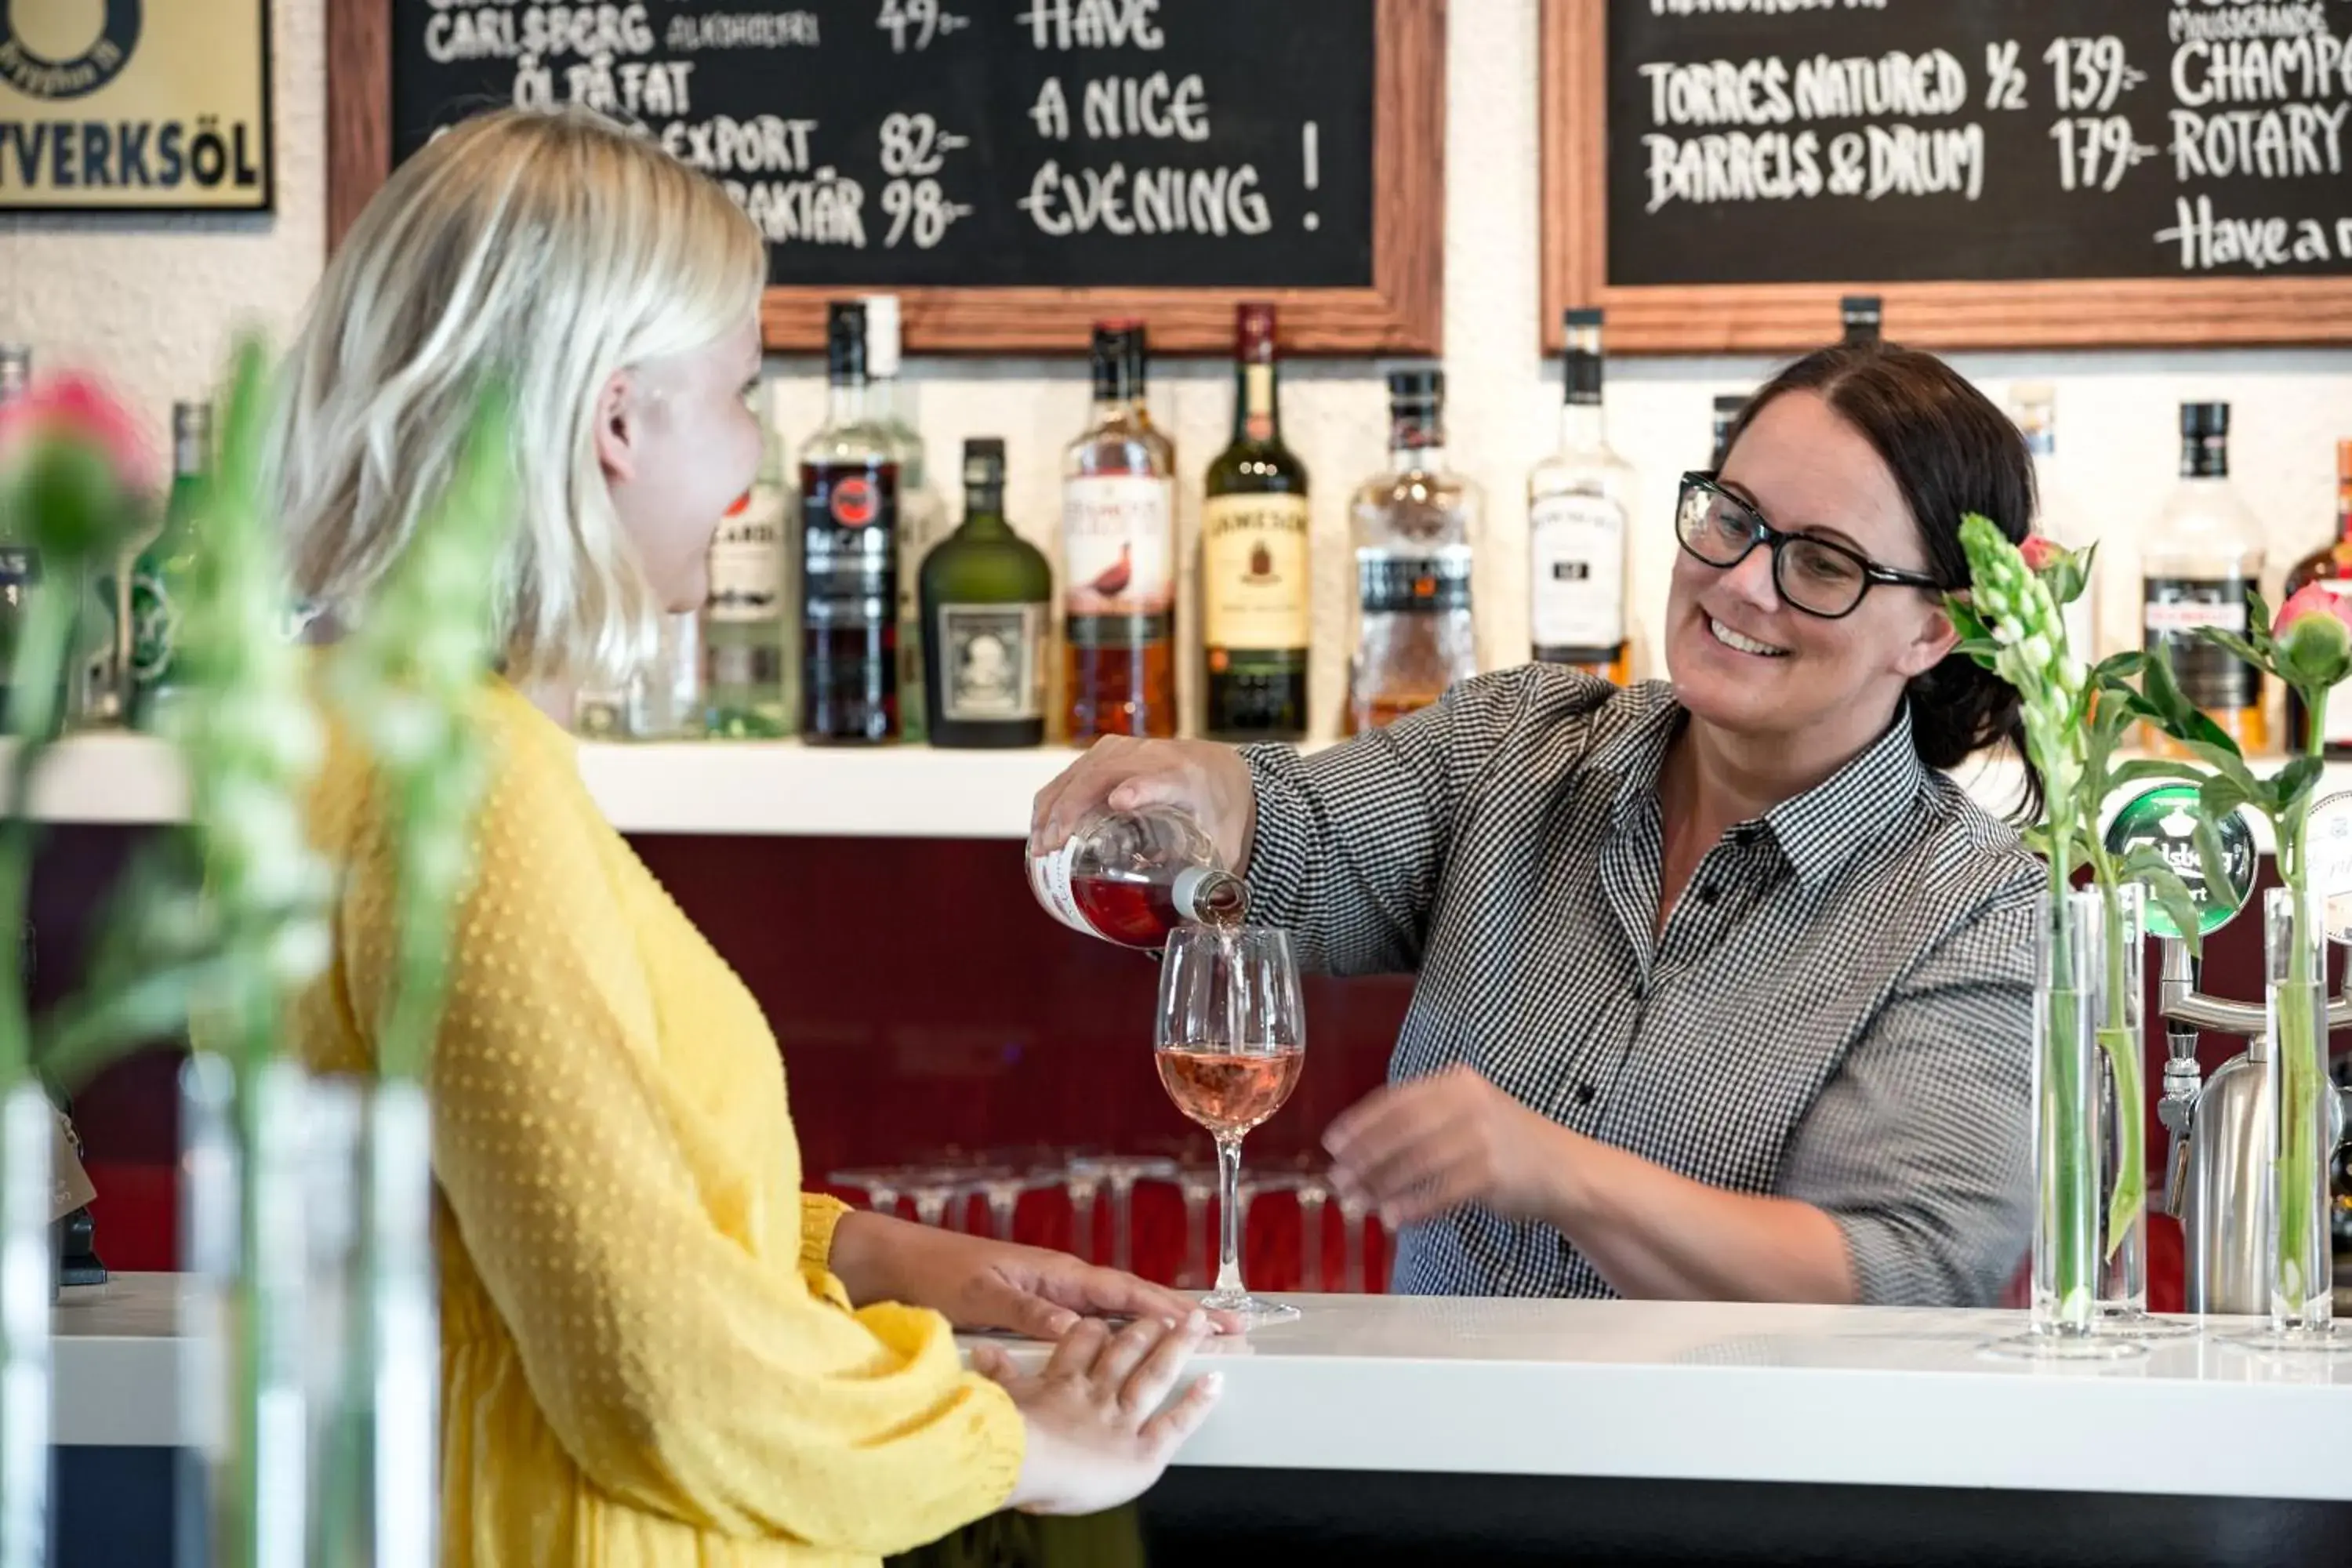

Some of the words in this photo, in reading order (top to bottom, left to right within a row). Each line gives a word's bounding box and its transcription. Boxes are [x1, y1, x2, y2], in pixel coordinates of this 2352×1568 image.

[424, 4, 654, 62] CARLSBERG
[1017, 0, 1164, 50] HAVE
[618, 61, 695, 116] FAT
[1029, 77, 1069, 140] A
[1082, 71, 1210, 141] NICE
[1639, 56, 1795, 126] TORRES
[660, 114, 818, 172] EXPORT
[1640, 130, 1824, 213] BARRELS
[1864, 122, 1984, 201] DRUM
[2166, 100, 2352, 182] ROTARY
[1017, 160, 1272, 236] EVENING
[2153, 194, 2291, 270] Have
[2292, 218, 2331, 263] a
